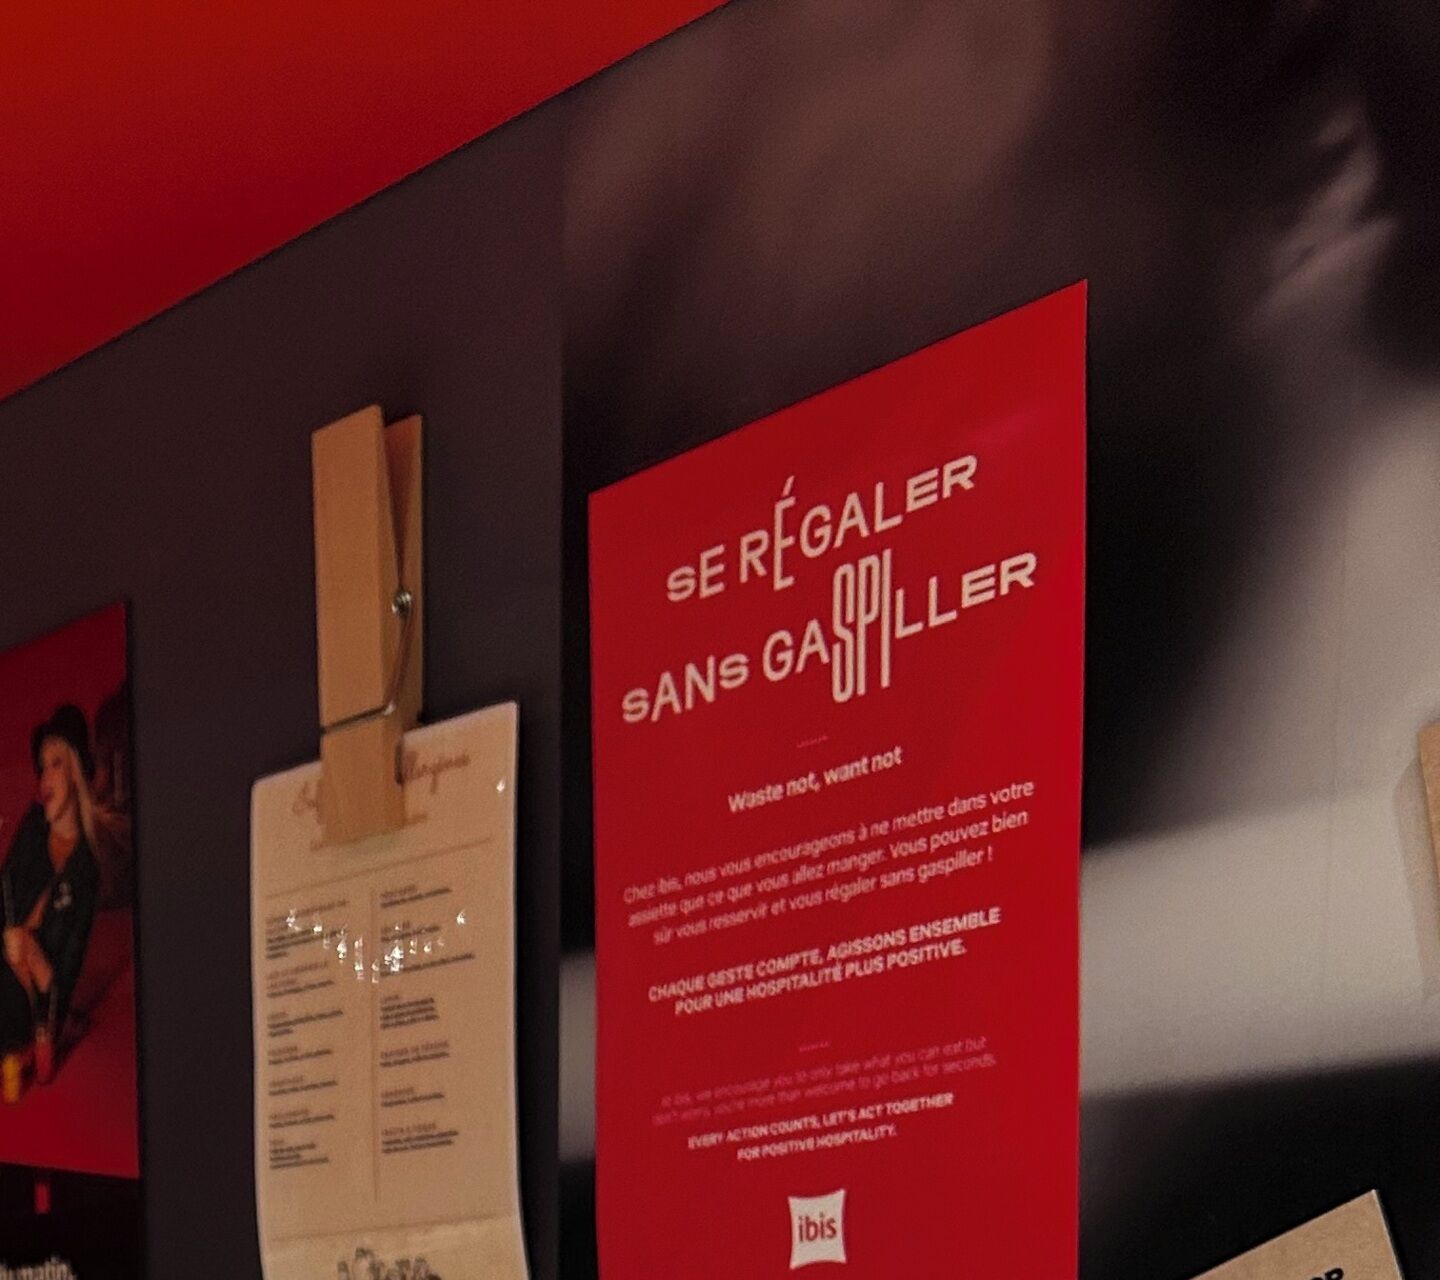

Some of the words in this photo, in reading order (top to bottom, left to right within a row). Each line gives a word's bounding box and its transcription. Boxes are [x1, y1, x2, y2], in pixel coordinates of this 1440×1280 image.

[666, 543, 726, 603] SE
[739, 454, 979, 592] RÉGALER
[621, 652, 750, 724] SANS
[762, 548, 1038, 704] GASPILLER
[728, 782, 785, 813] Waste
[786, 770, 821, 793] not,
[823, 756, 869, 786] want
[871, 745, 903, 773] not
[623, 882, 656, 905] Chez
[684, 866, 718, 887] nous
[719, 856, 752, 877] vous
[753, 828, 856, 869] encourageons
[858, 821, 868, 841] à
[870, 820, 891, 837] ne
[892, 804, 945, 832] mettre
[947, 792, 988, 817] dans
[990, 780, 1035, 806] votre
[627, 900, 678, 929] assiette
[679, 894, 705, 915] que
[707, 889, 725, 907] ce
[726, 882, 755, 903] que
[756, 873, 789, 893] vous
[792, 862, 825, 885] allez
[826, 847, 889, 876] manger.
[889, 835, 929, 859] Vous
[929, 820, 989, 853] pouvez
[991, 809, 1030, 834] bien
[675, 917, 708, 938] vous
[709, 900, 769, 930] resservir
[771, 898, 787, 916] et
[789, 890, 823, 910] vous
[824, 874, 878, 904] régaler
[880, 865, 915, 889] sans
[916, 847, 985, 884] gaspiller
[648, 973, 706, 1003] CHAQUE
[706, 962, 755, 990] GESTE
[826, 927, 908, 962] AGISSONS
[908, 905, 1002, 944] ENSEMBLE
[674, 993, 713, 1017] POUR
[714, 985, 745, 1009] UNE
[745, 960, 844, 1001] HOSPITALITÉ
[844, 955, 885, 980] PLUS
[886, 937, 969, 971] POSITIVE.
[687, 1131, 725, 1150] EVERY
[726, 1124, 769, 1143] ACTION
[858, 1103, 885, 1120] ACT
[885, 1091, 955, 1116] TOGETHER
[736, 1146, 761, 1162] FOR
[762, 1135, 816, 1158] POSITIVE
[797, 1212, 838, 1243] ibis
